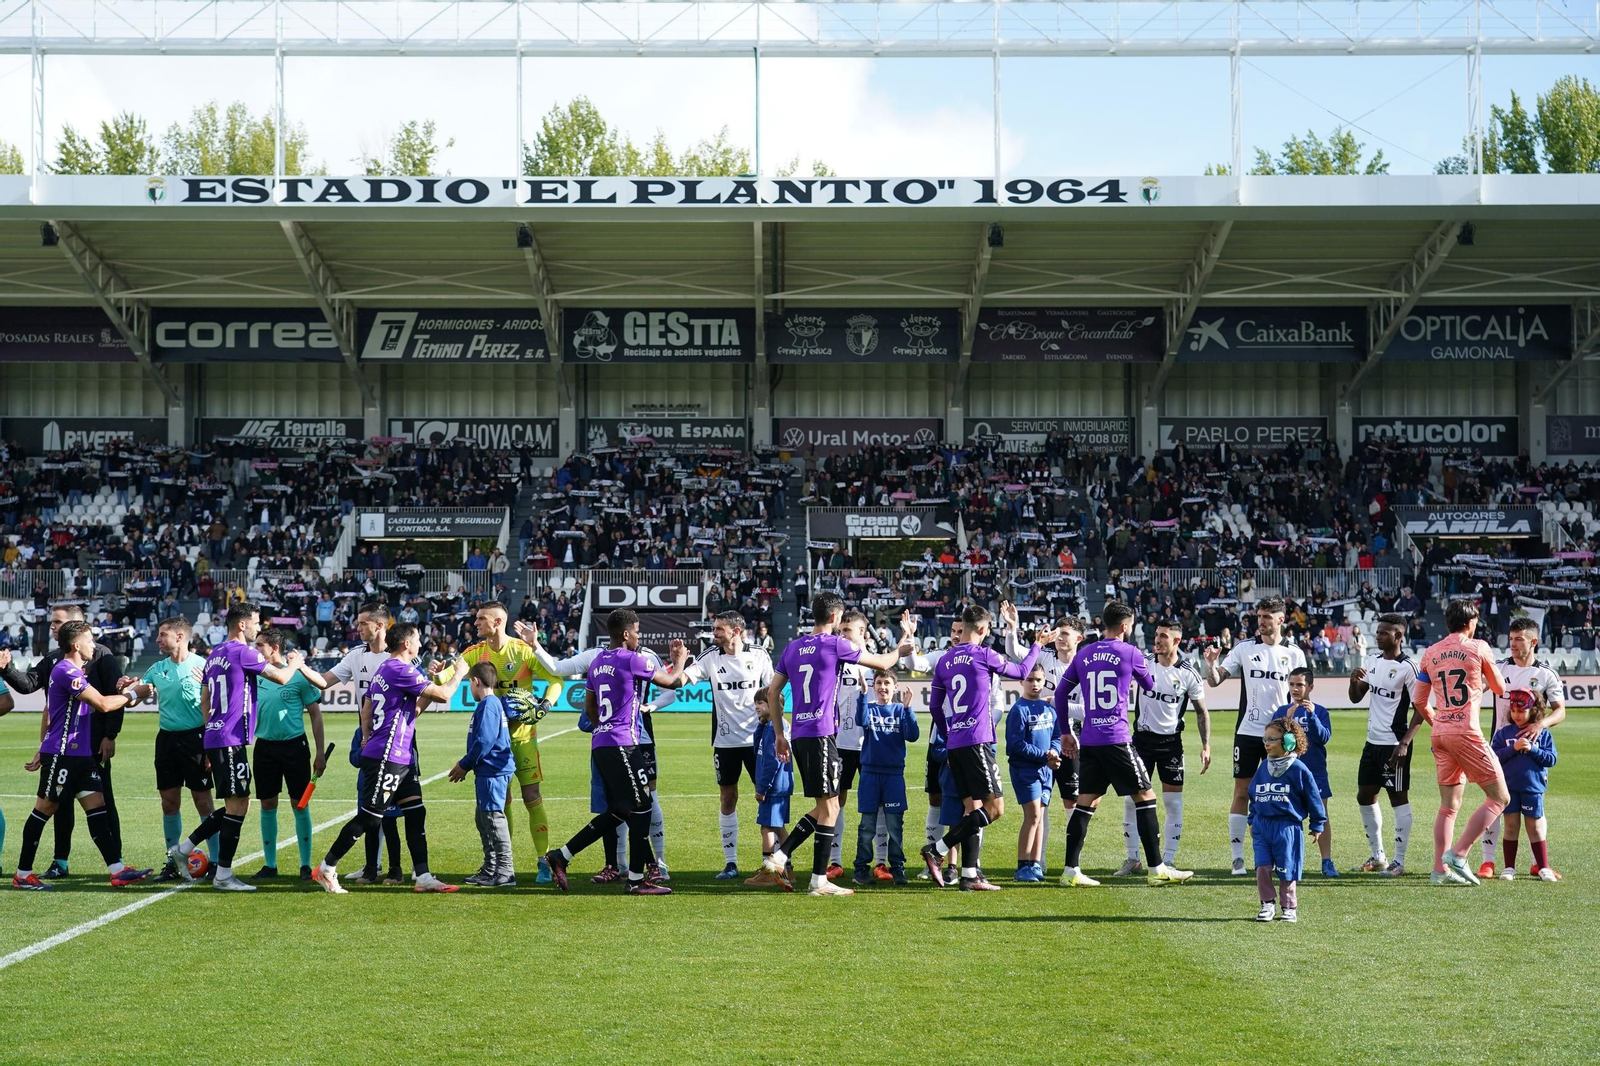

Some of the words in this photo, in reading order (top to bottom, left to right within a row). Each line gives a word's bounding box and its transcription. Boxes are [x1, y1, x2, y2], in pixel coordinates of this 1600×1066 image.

[181, 178, 489, 204] ESTADIO
[502, 179, 617, 204] "EL
[630, 178, 956, 204] PLANTIO"
[972, 178, 1127, 204] 1964
[418, 319, 495, 331] HORMIGONES
[502, 319, 545, 331] ARIDOS
[793, 314, 827, 328] deporte
[908, 314, 942, 328] deporte
[54, 332, 94, 343] REALES
[156, 322, 340, 348] correa
[1068, 320, 1136, 341] Encantado
[1235, 320, 1354, 343] CaixaBank
[624, 348, 661, 357] Reciclaje
[663, 348, 672, 356] de
[674, 348, 703, 356] aceites
[705, 348, 742, 358] vegetales
[1431, 346, 1514, 360] GAMONAL
[285, 420, 346, 436] Ferralla
[681, 423, 745, 438] ESPAÑA
[1011, 421, 1058, 432] SERVICIOS
[1358, 420, 1506, 443] rotucolor
[808, 430, 847, 446] Ural
[853, 430, 910, 447] Motor
[1089, 434, 1110, 444] 008
[1186, 427, 1250, 443] PABLO
[1256, 427, 1322, 443] PEREZ
[455, 517, 503, 526] SEGURIDAD
[845, 514, 898, 526] Green
[1428, 511, 1506, 521] AUTOCARES
[847, 525, 899, 537] Natur
[1405, 520, 1531, 534] RAMILA
[599, 586, 699, 606] DIGI
[668, 631, 687, 639] 2031
[946, 660, 953, 670] P.
[954, 654, 974, 667] ORTIZ
[1093, 652, 1122, 666] SINTES
[1441, 650, 1468, 661] MARÍN
[718, 680, 757, 691] DIGI
[798, 663, 814, 704] 7
[1086, 670, 1118, 711] 15
[1437, 669, 1469, 708] 13
[952, 674, 969, 714] 2
[1142, 689, 1180, 703] DIGI
[599, 683, 613, 723] 5
[58, 769, 68, 785] 8
[236, 762, 250, 779] 21
[638, 768, 649, 785] 5
[382, 773, 400, 792] 23
[1255, 783, 1290, 794] DIGI
